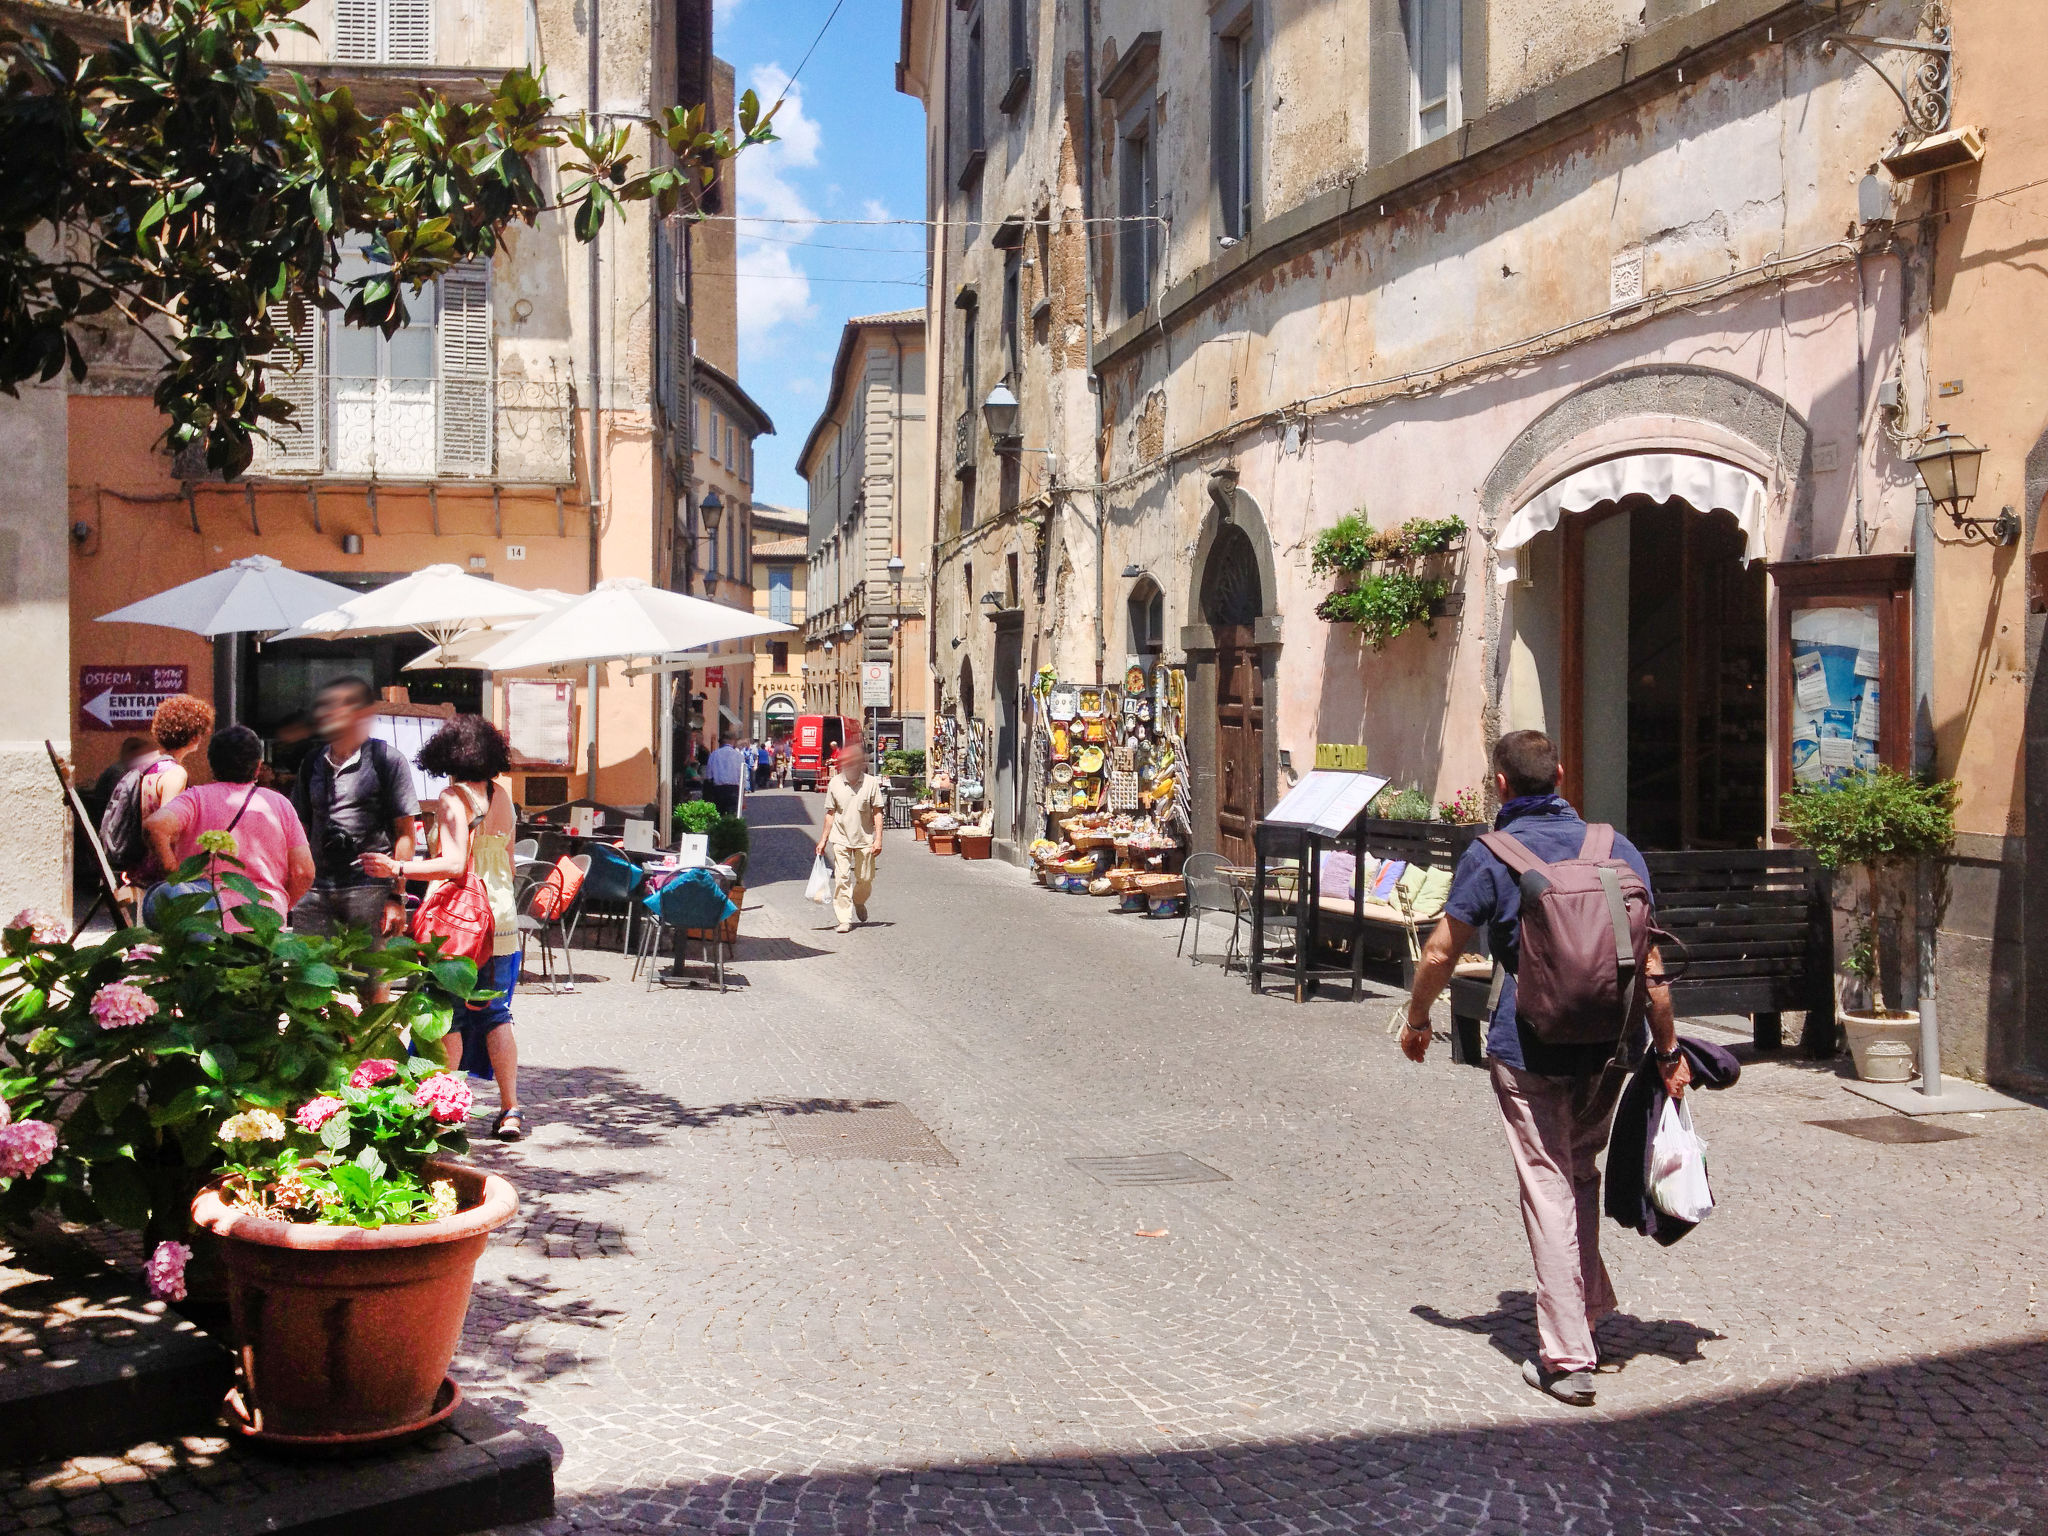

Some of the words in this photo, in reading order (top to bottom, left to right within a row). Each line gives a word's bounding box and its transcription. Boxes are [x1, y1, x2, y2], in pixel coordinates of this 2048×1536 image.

[512, 548, 521, 557] 14
[85, 671, 132, 686] OSTERIA
[758, 684, 805, 692] FARMACIA
[109, 709, 143, 718] INSIDE
